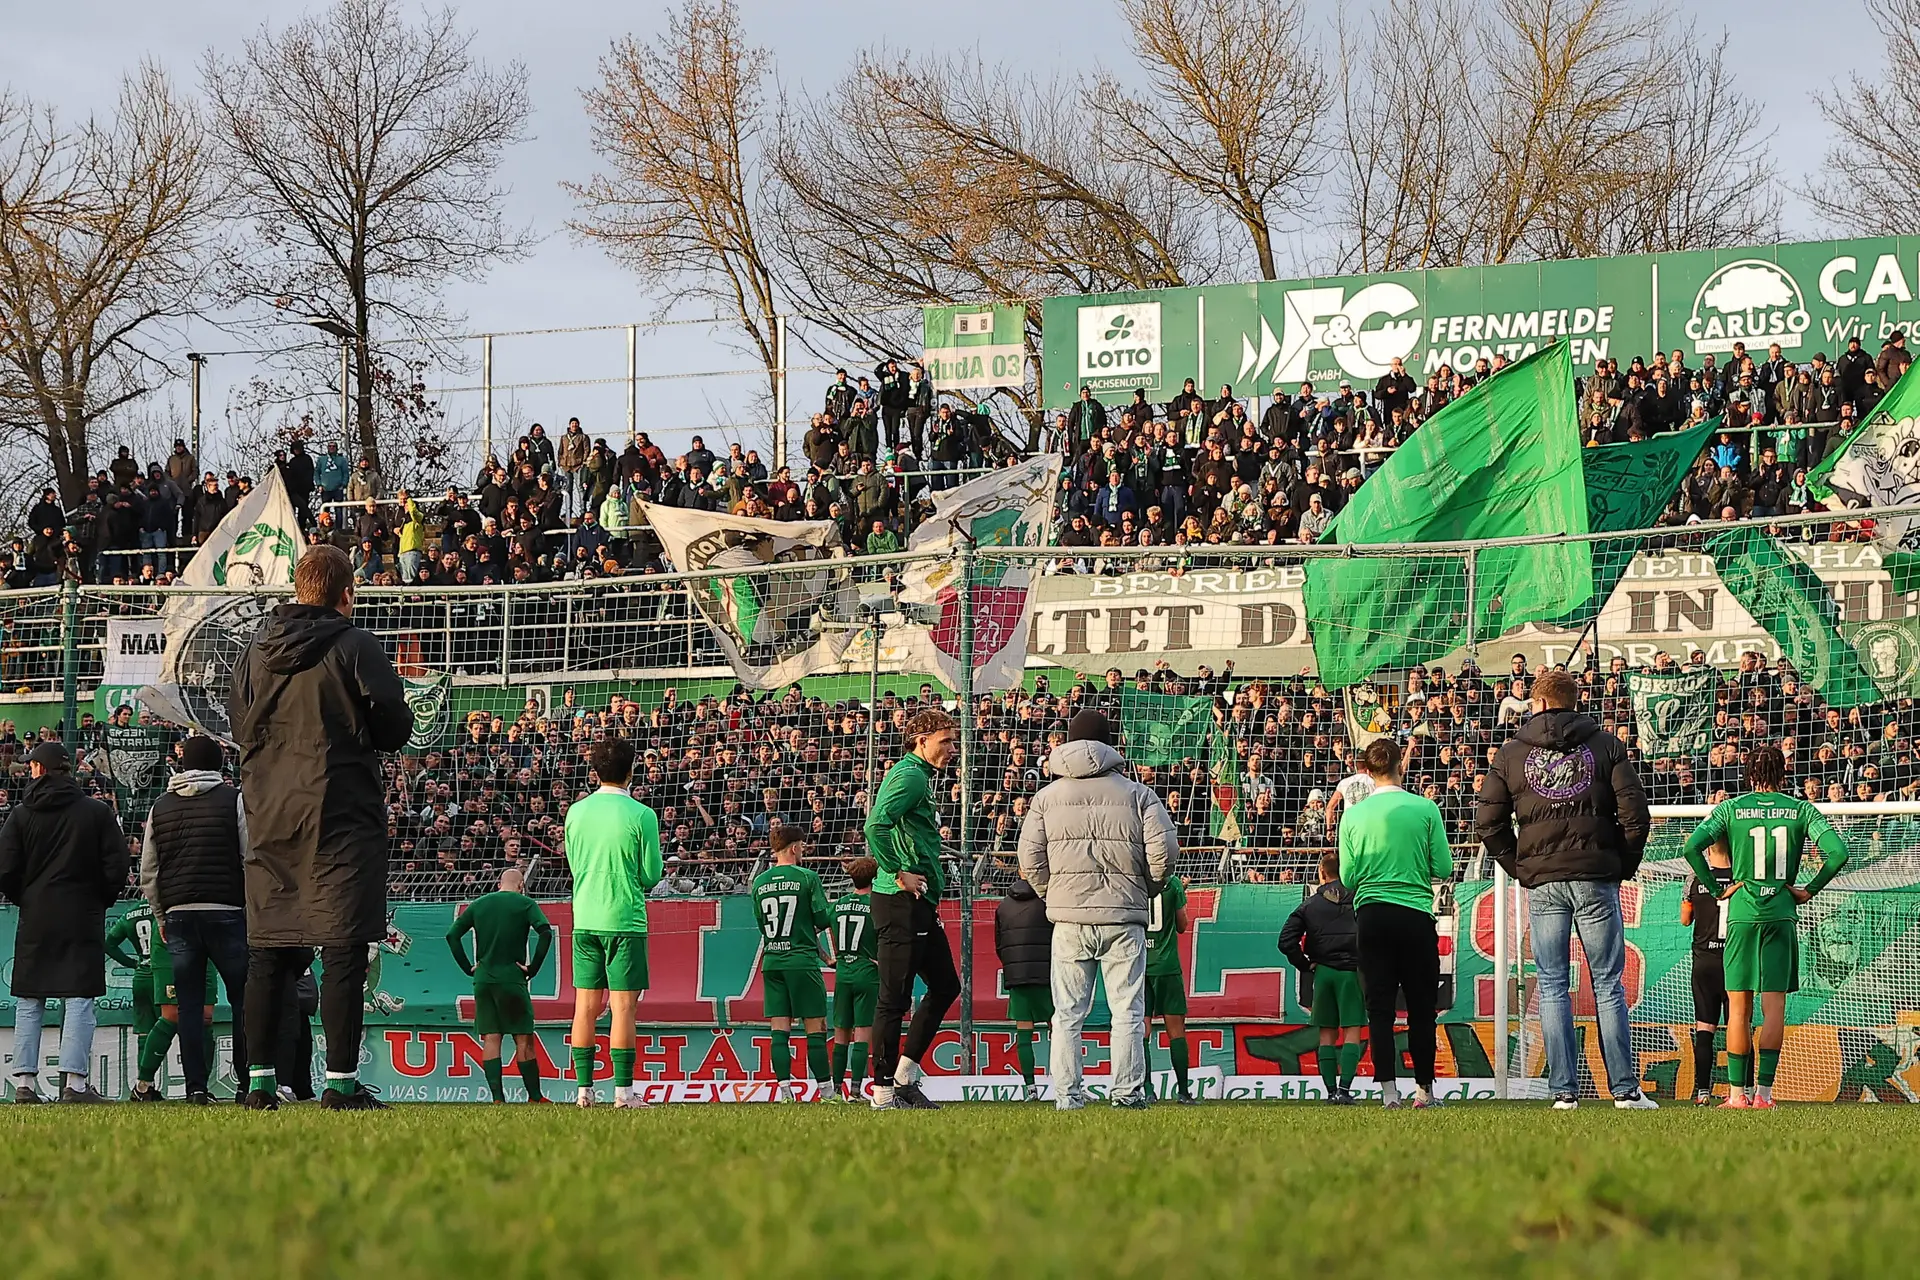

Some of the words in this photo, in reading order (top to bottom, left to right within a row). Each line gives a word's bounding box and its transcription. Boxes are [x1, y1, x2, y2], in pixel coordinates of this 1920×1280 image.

[1818, 252, 1920, 307] CA
[1430, 305, 1614, 344] FERNMELDE
[1684, 309, 1811, 341] CARUSO
[1822, 315, 1872, 343] Wir
[992, 354, 1021, 378] 03
[1087, 347, 1152, 369] LOTTO
[1423, 337, 1609, 375] MONTAEN
[1086, 376, 1153, 390] SACHSENLOTTO
[1307, 368, 1343, 381] GMBH
[1626, 587, 1719, 634] IN
[120, 633, 167, 655] MA
[1735, 808, 1766, 820] CHEMIE
[1767, 808, 1798, 820] LEIPZIG
[1749, 826, 1787, 880] 11
[758, 883, 777, 896] CHEMIE
[778, 881, 801, 891] LEIPZIG
[761, 895, 798, 938] 37
[852, 902, 871, 914] LEIPZIG
[136, 920, 151, 956] 8
[837, 915, 866, 951] 17
[388, 1084, 428, 1100] WAS
[436, 1085, 476, 1101] WIR
